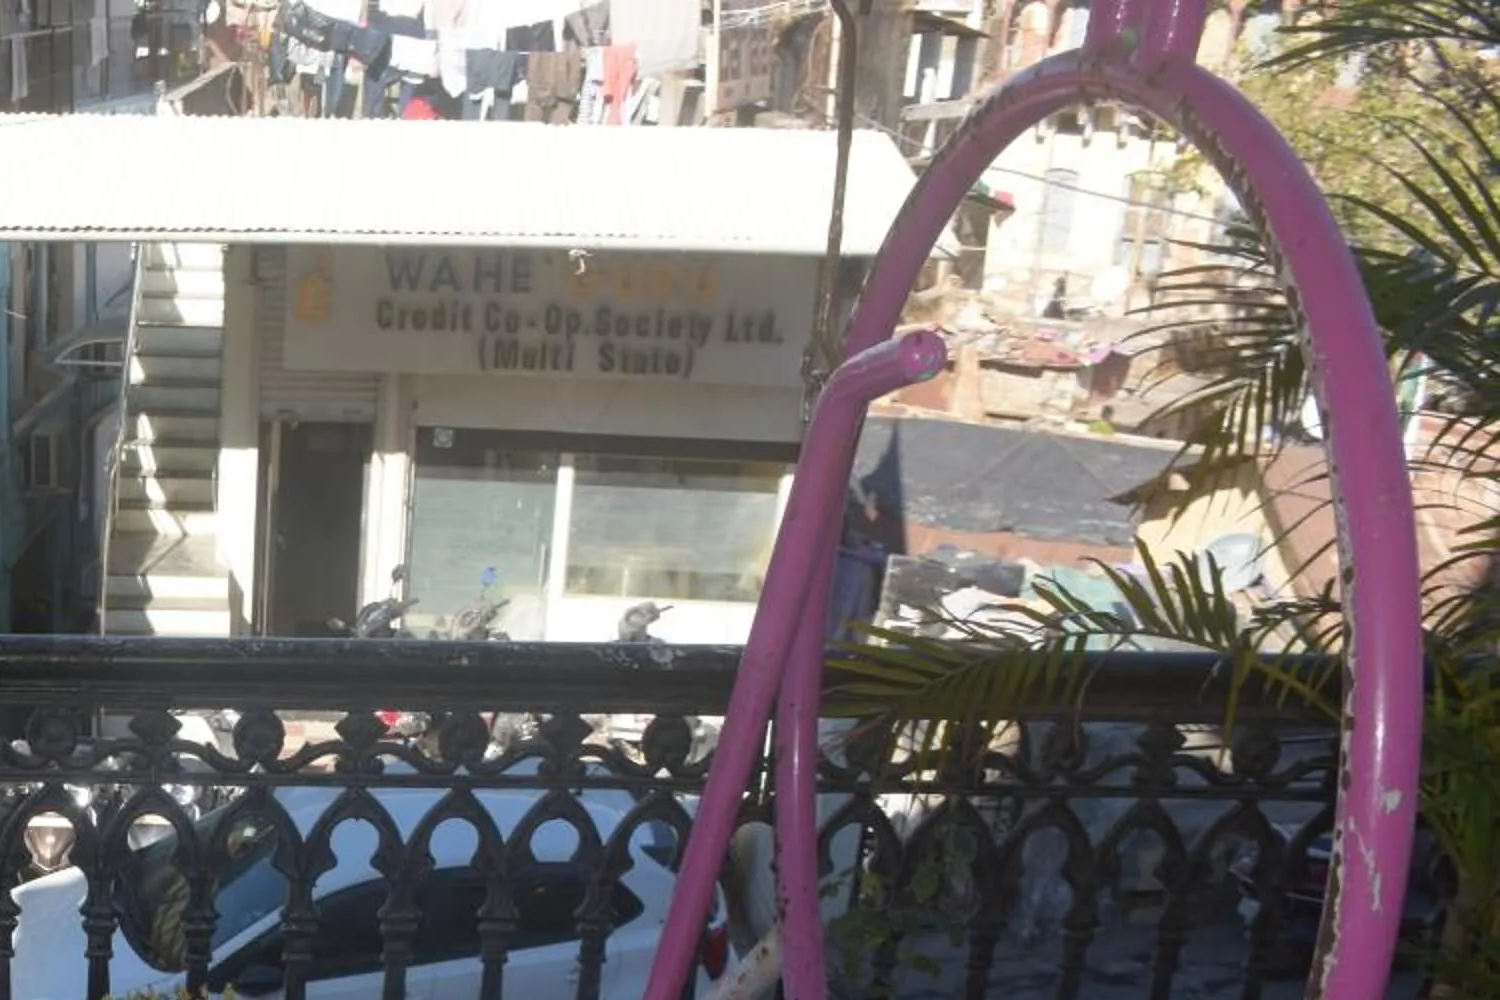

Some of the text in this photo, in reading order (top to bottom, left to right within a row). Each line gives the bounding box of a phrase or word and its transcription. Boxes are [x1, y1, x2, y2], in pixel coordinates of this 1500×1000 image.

[386, 252, 532, 292] WAHE
[376, 298, 474, 332] Credit
[725, 304, 785, 344] Ltd.
